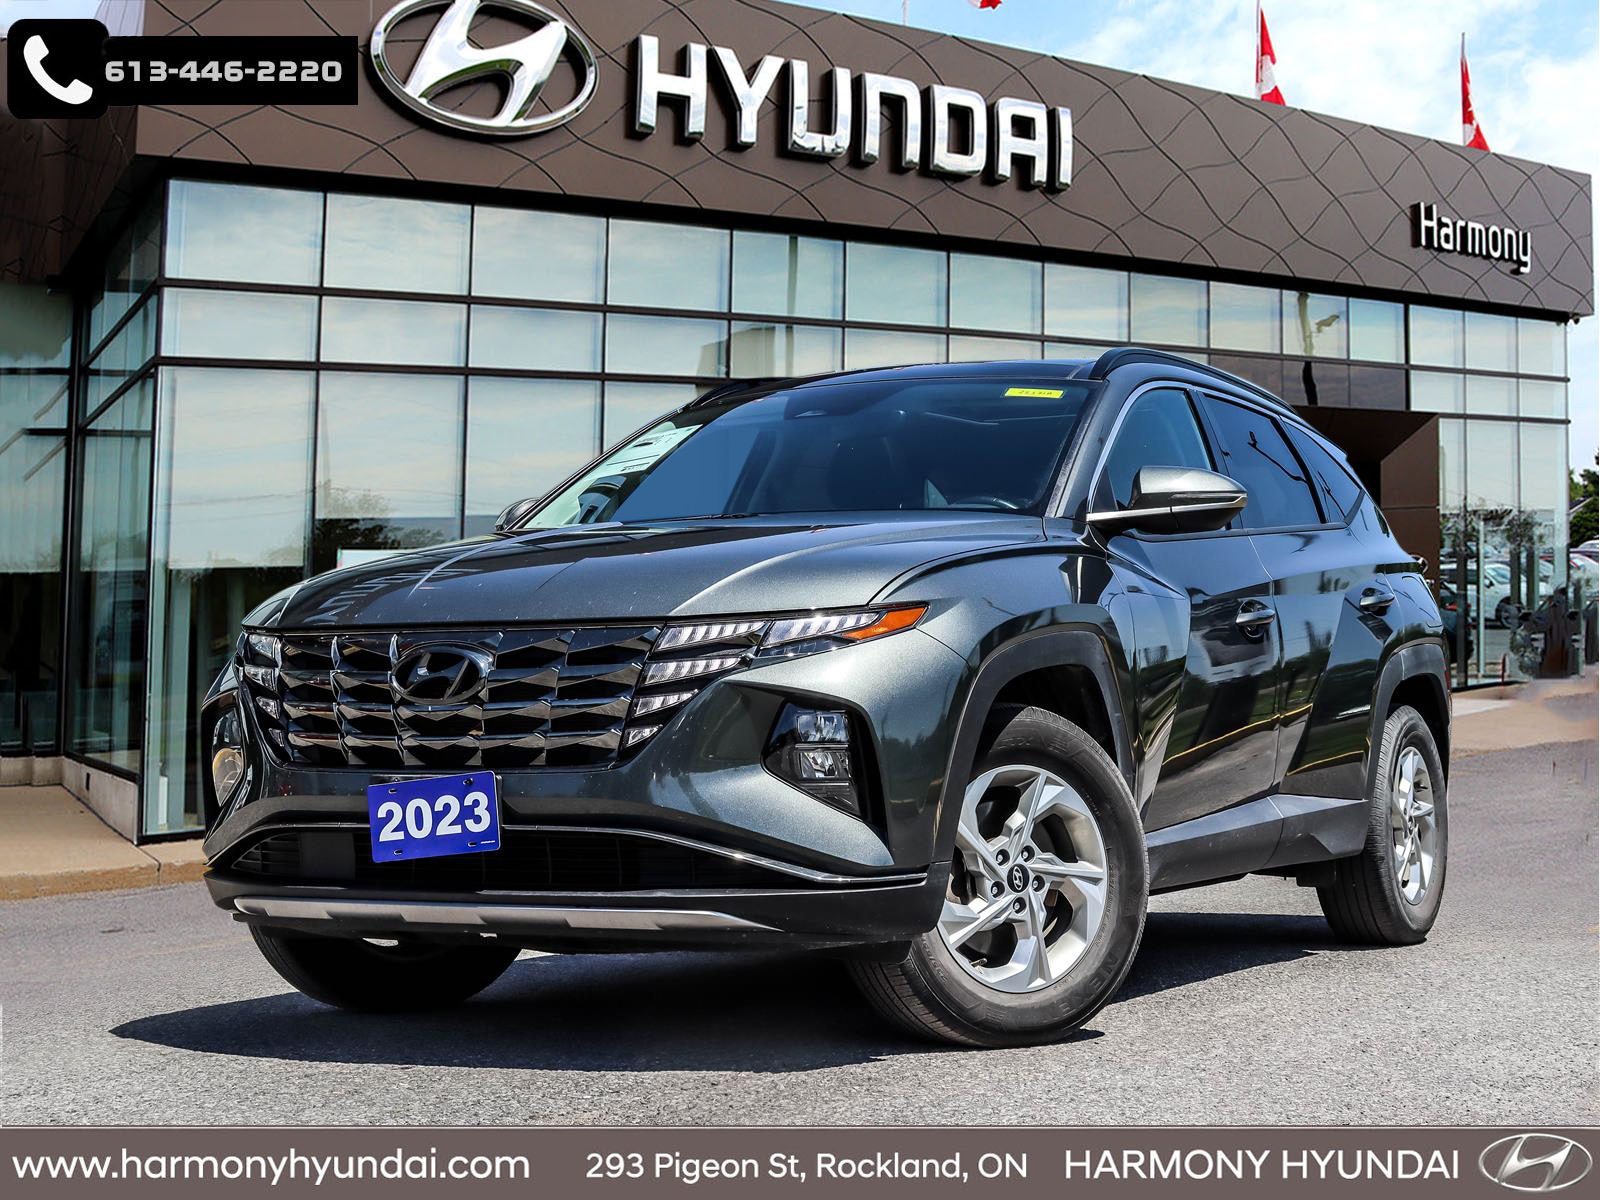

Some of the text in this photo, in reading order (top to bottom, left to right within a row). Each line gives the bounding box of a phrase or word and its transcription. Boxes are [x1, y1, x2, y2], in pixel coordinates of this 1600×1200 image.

[636, 34, 1074, 190] HYUNDAI
[1418, 201, 1532, 273] Harmony
[377, 791, 491, 842] 2023
